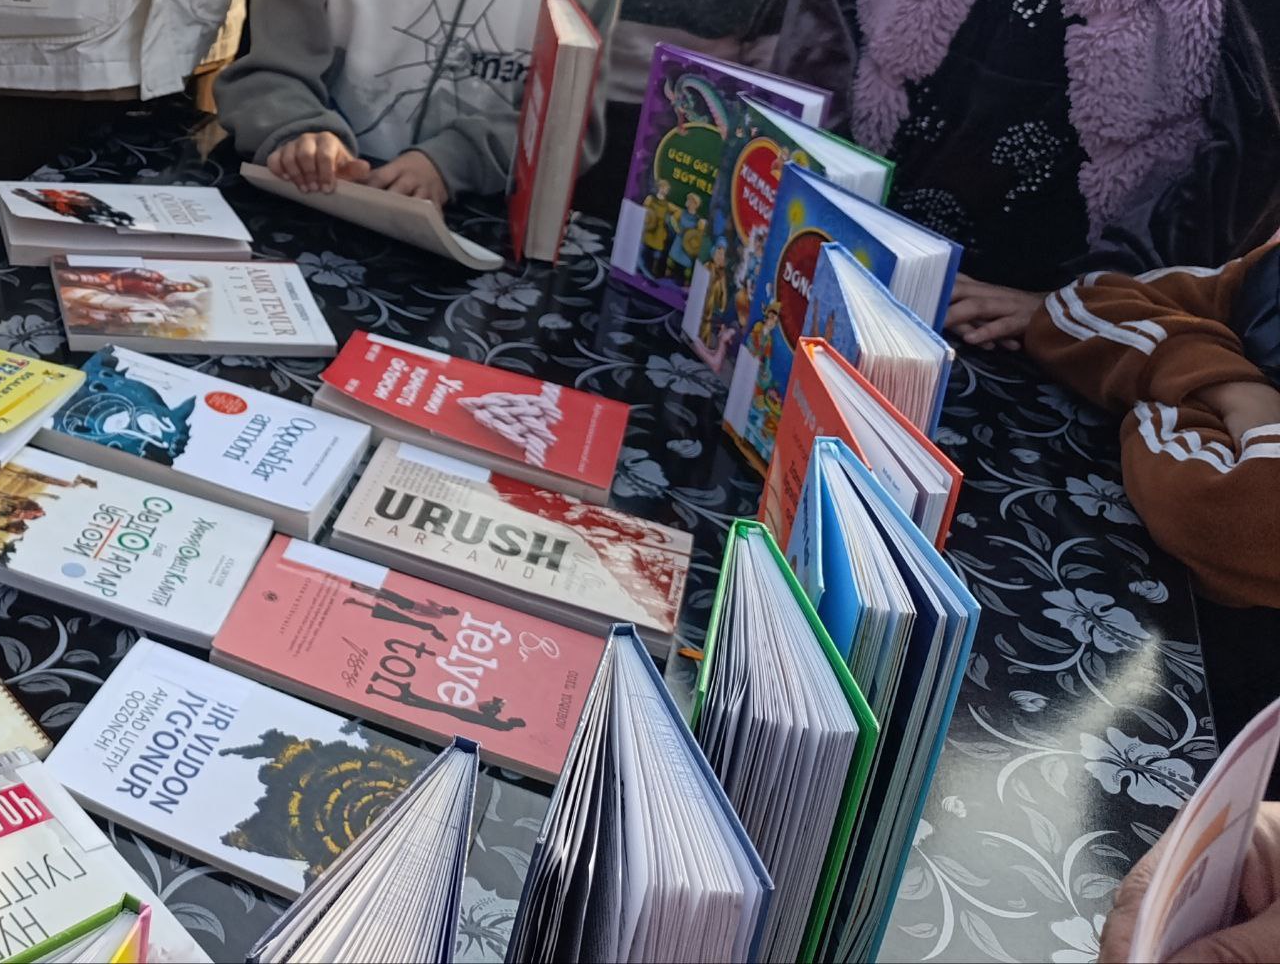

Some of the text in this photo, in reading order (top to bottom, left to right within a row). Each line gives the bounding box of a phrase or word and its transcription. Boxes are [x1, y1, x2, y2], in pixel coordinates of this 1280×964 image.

[245, 266, 277, 293] AMIR
[259, 297, 297, 335] TEMUR
[222, 412, 271, 464] armoni
[250, 415, 316, 482] Oqqushlar
[62, 504, 127, 557] УСТОЗИ
[363, 518, 558, 588] FARZANDI
[373, 485, 571, 573] URUSH
[365, 641, 435, 704] ton
[435, 611, 511, 708] felye
[93, 688, 146, 751] QOZONCHI
[100, 686, 167, 772] AHMAD LUTFIY
[148, 733, 220, 814] VIJDON
